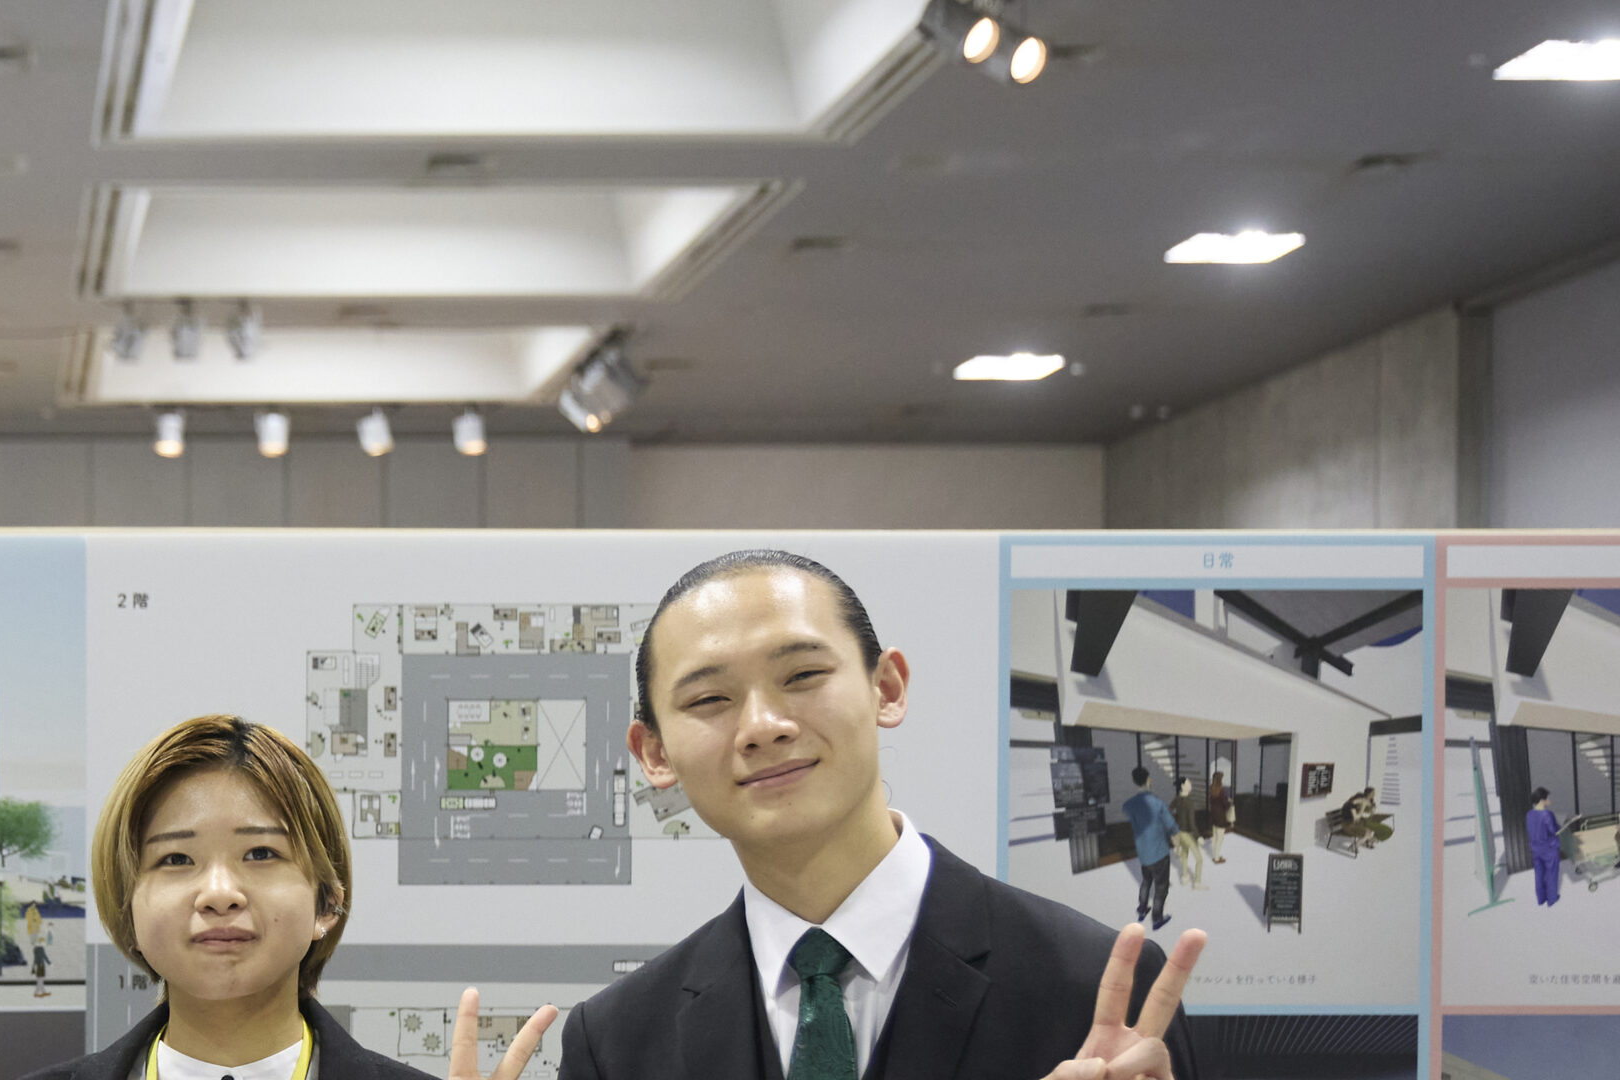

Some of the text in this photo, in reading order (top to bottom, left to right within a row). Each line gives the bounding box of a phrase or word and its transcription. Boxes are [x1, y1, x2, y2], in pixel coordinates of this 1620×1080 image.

[1203, 552, 1234, 569] 日常
[1189, 974, 1317, 986] マルシェを行っている様子
